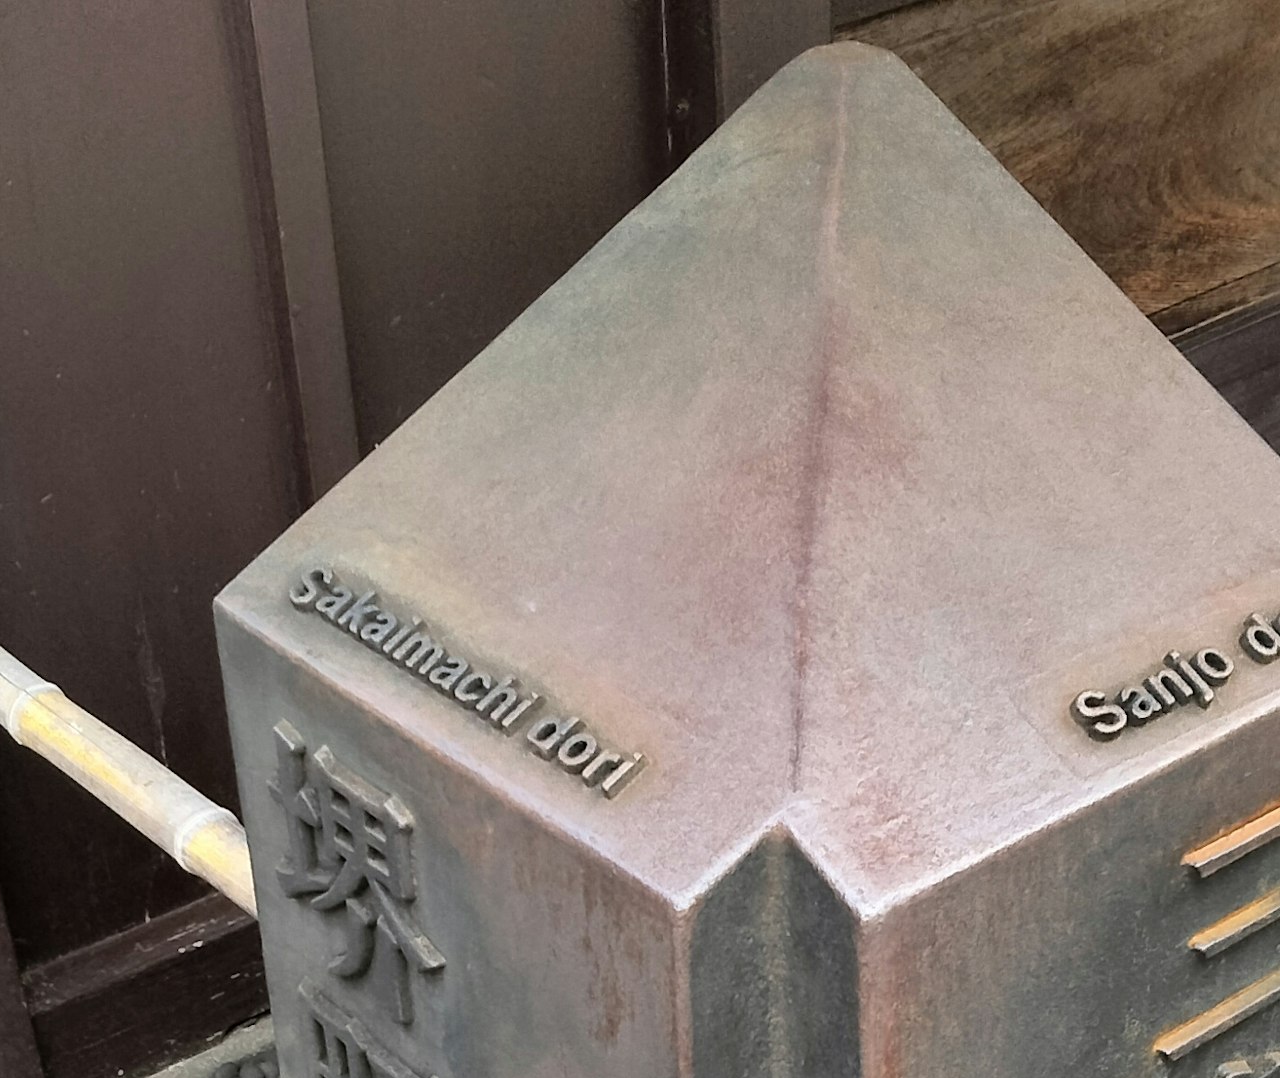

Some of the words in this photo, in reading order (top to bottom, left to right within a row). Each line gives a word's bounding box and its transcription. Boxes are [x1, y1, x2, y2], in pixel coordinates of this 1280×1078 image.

[288, 566, 540, 737] Sakaimachi
[526, 716, 648, 801] dori
[1070, 649, 1235, 742] Sanjo
